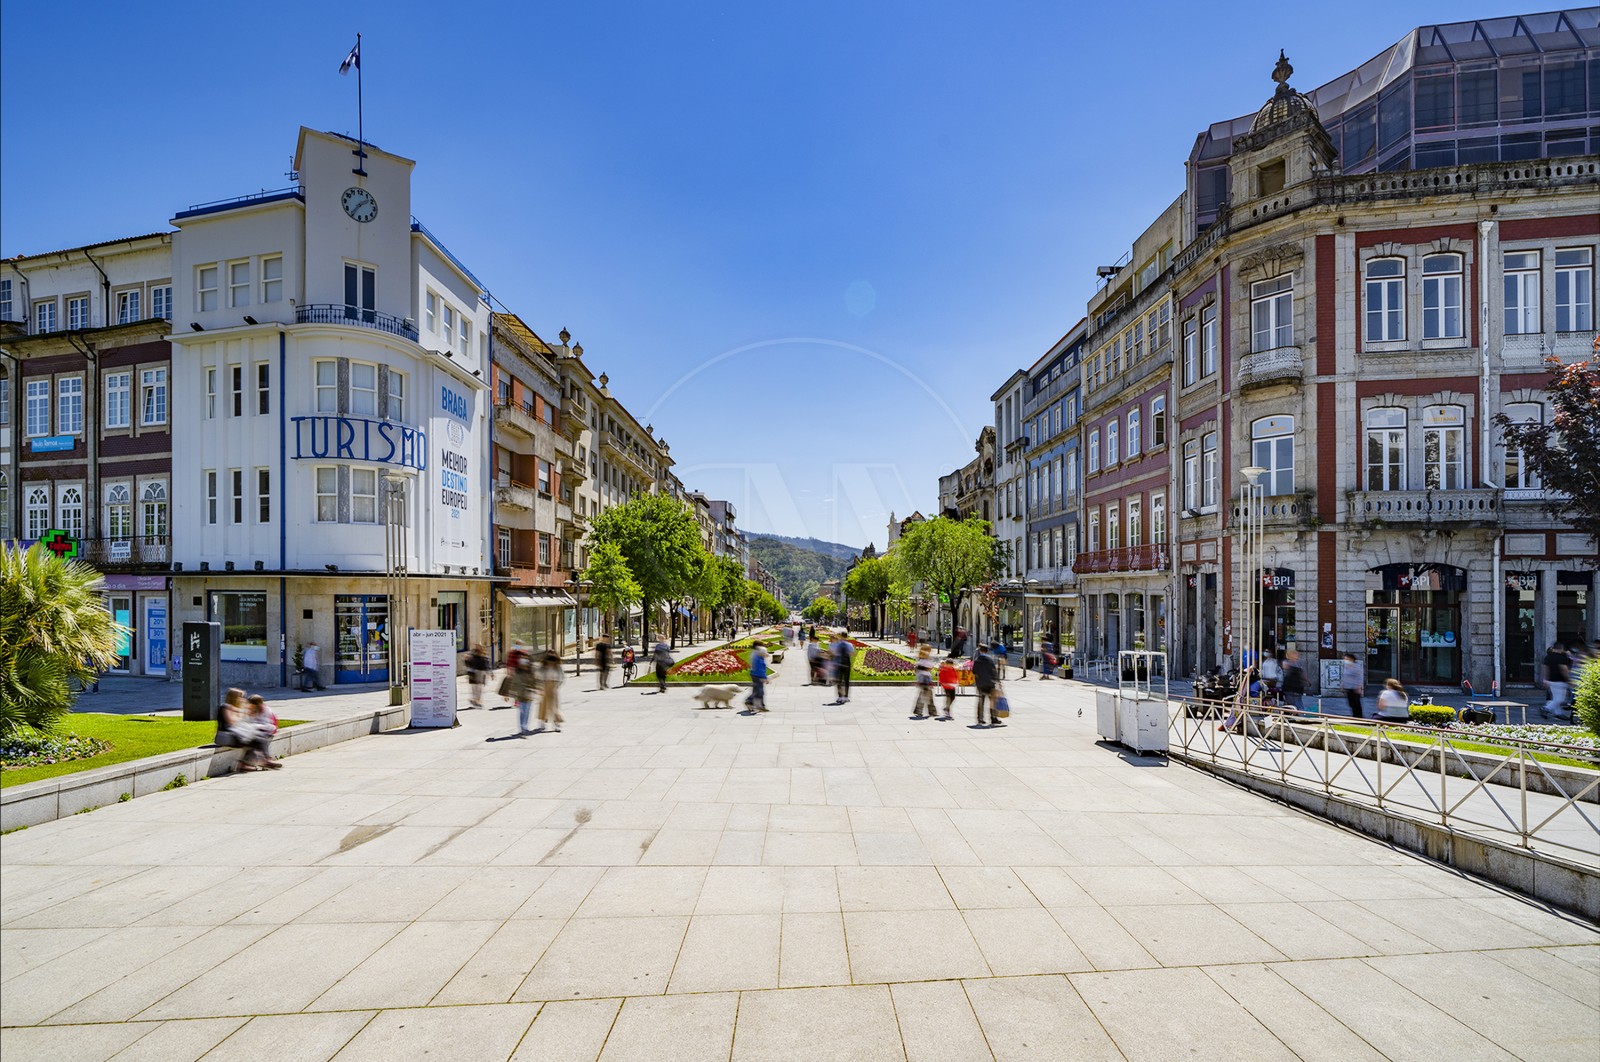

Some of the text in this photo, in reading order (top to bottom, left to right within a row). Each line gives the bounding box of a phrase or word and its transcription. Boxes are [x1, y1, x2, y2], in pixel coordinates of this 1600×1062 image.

[442, 386, 468, 422] BRAGA
[290, 416, 427, 471] TURISMO
[442, 448, 468, 476] MELHOR
[442, 470, 468, 493] DESTINO
[442, 491, 468, 510] EUROPEU
[1273, 576, 1290, 586] BPI
[1412, 576, 1430, 586] BPI
[1519, 576, 1536, 586] BPI
